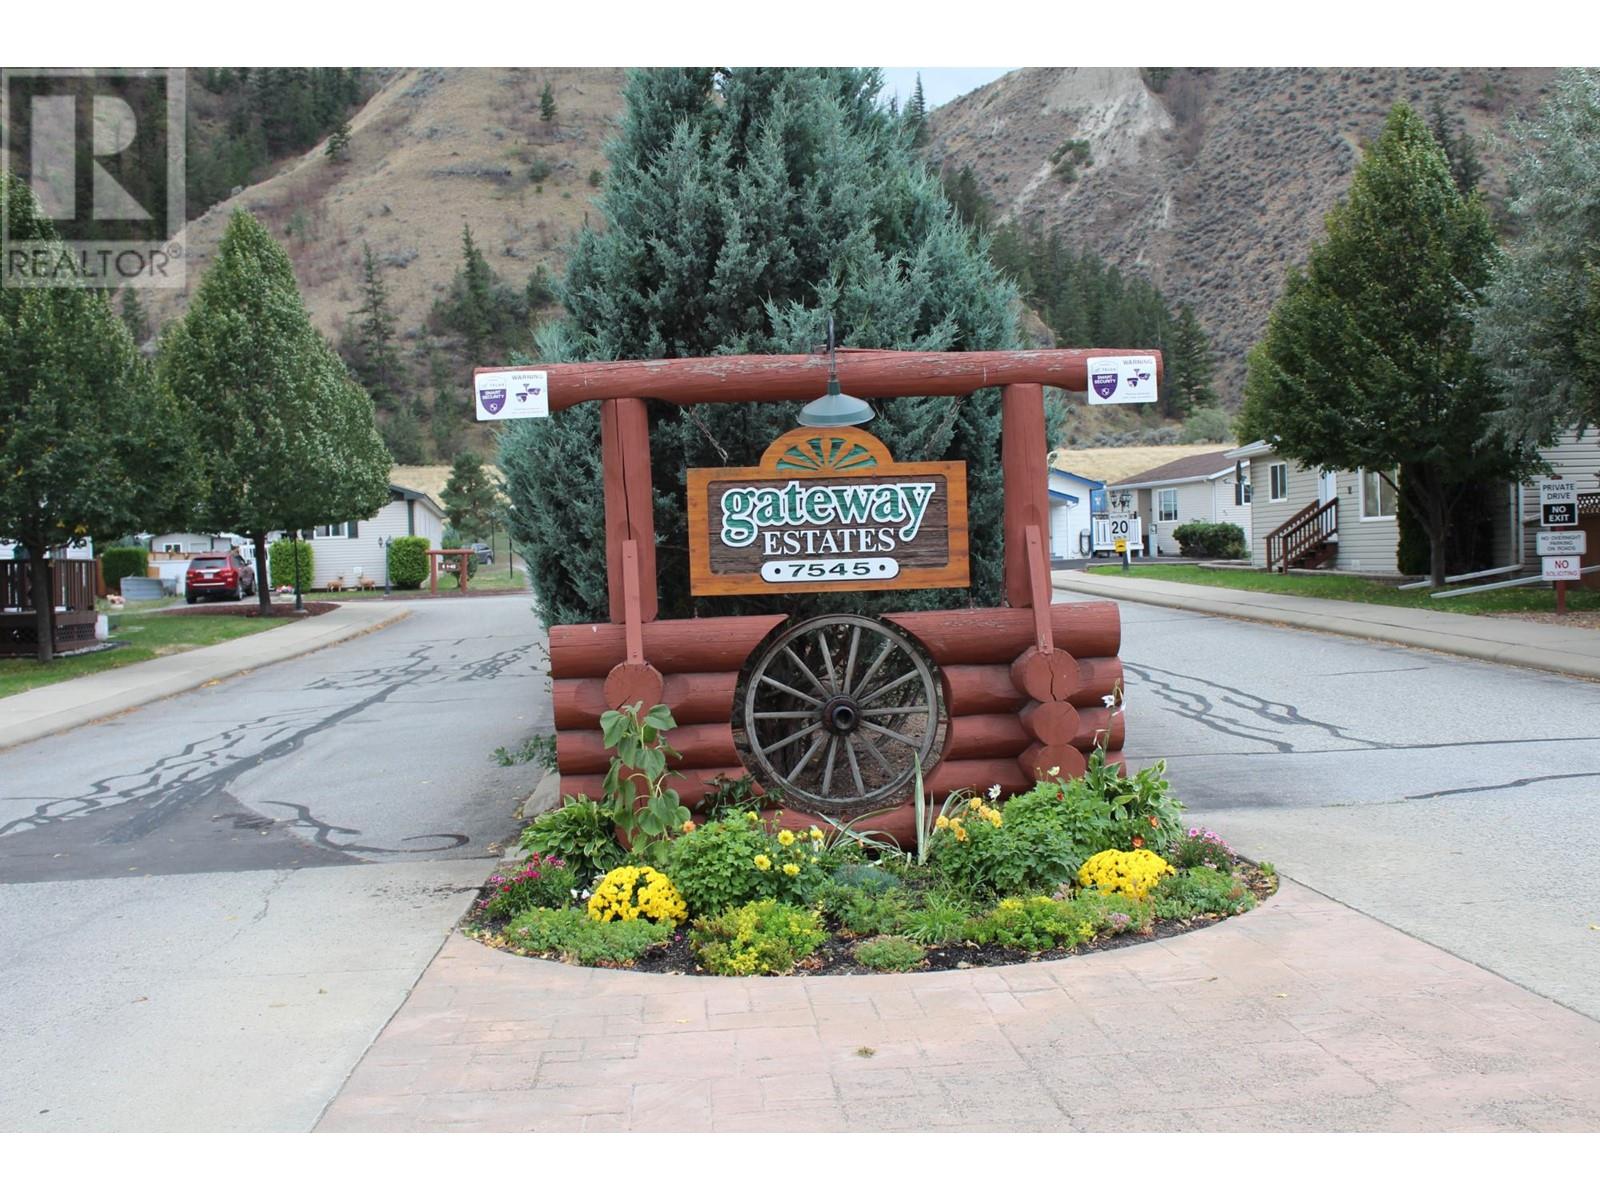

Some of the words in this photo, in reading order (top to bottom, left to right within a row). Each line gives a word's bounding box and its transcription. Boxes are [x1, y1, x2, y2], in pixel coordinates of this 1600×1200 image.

[1542, 483, 1575, 491] PRIVATE
[1547, 492, 1571, 500] DRIVE
[1552, 505, 1567, 513] NO
[721, 481, 936, 548] gateway
[1549, 514, 1570, 522] EXIT
[1111, 520, 1129, 534] 20
[762, 527, 896, 555] ESTATES
[1554, 560, 1569, 569] NO
